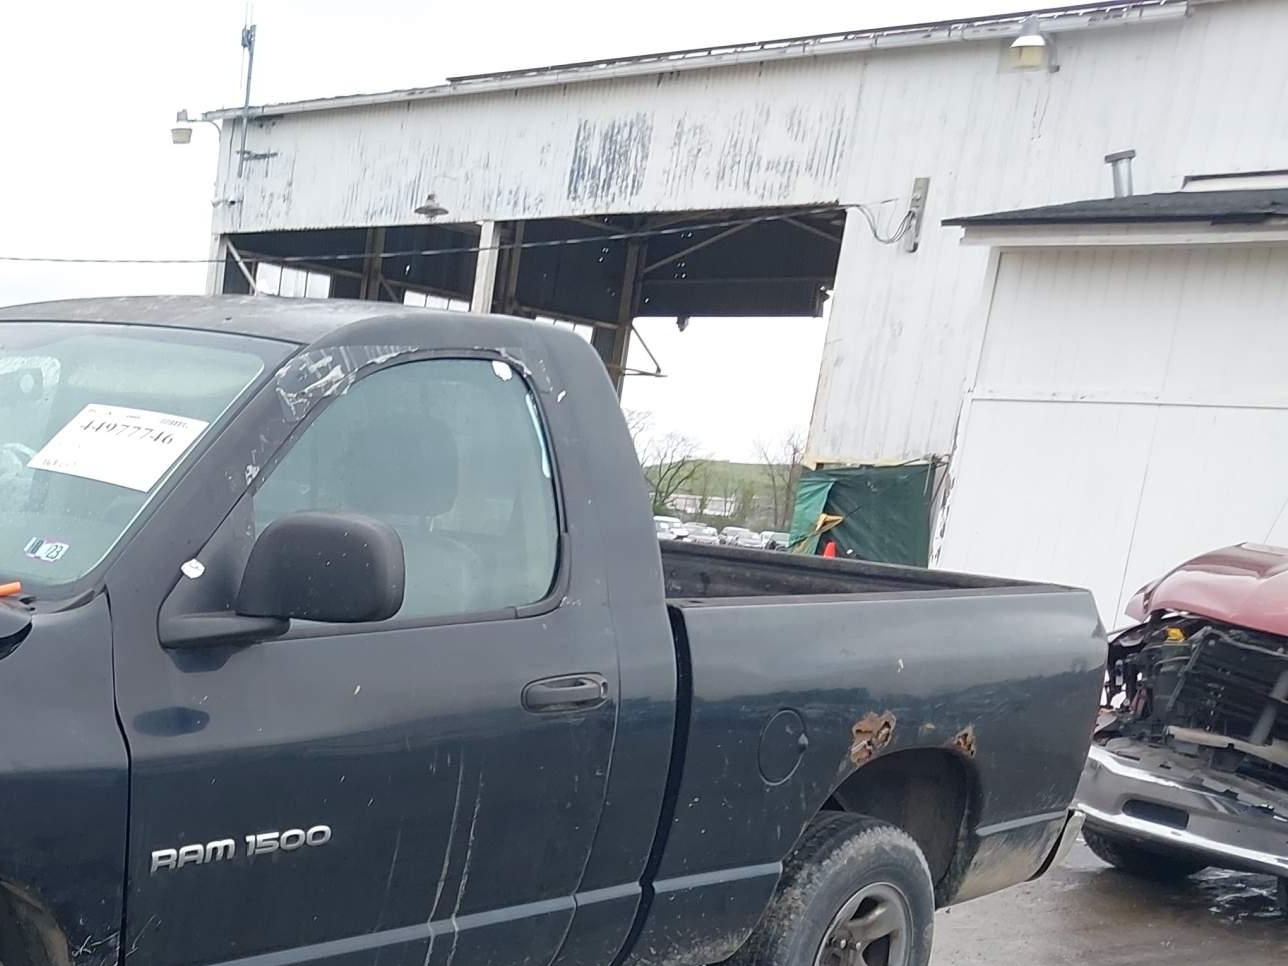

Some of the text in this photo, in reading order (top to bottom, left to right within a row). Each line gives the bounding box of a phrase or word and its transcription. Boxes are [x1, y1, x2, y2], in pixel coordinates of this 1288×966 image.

[79, 419, 175, 446] 44977746
[150, 825, 332, 873] RAM 1500
